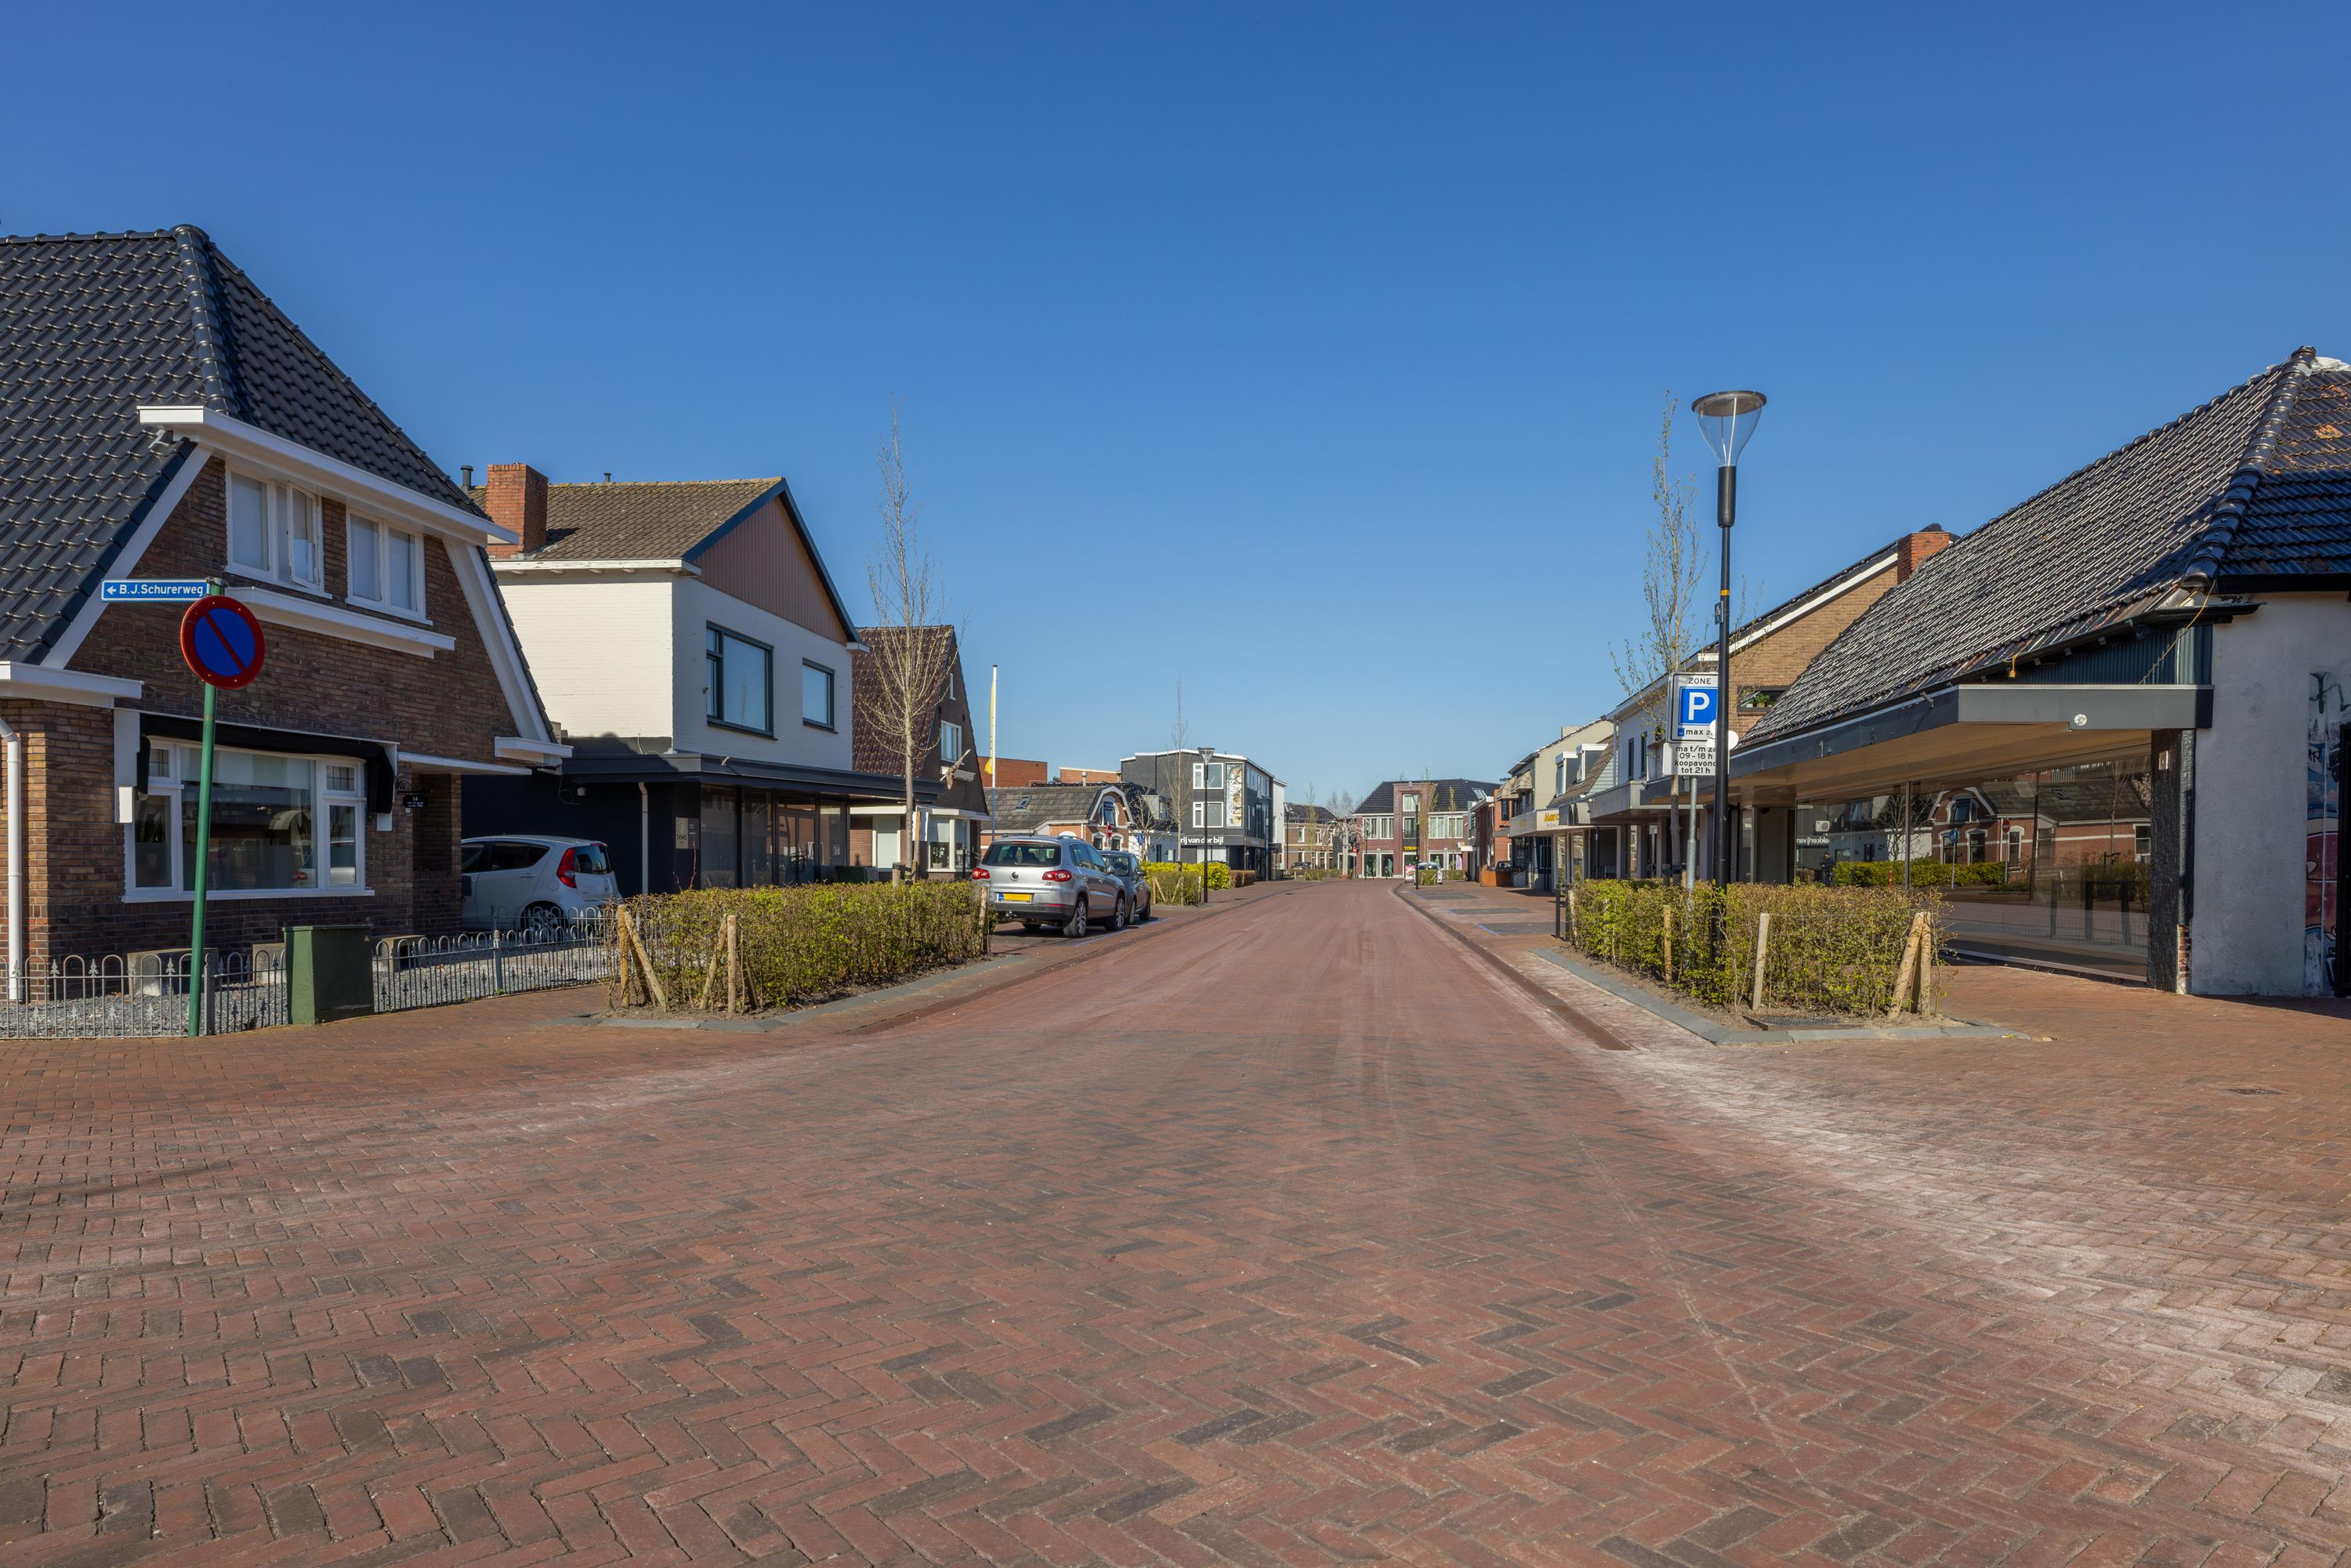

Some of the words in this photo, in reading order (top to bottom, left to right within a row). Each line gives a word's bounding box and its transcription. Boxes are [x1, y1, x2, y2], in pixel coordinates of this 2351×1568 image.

[119, 584, 204, 597] B.J.Schurerweg
[1689, 692, 1710, 720] P
[1213, 836, 1224, 845] bijl
